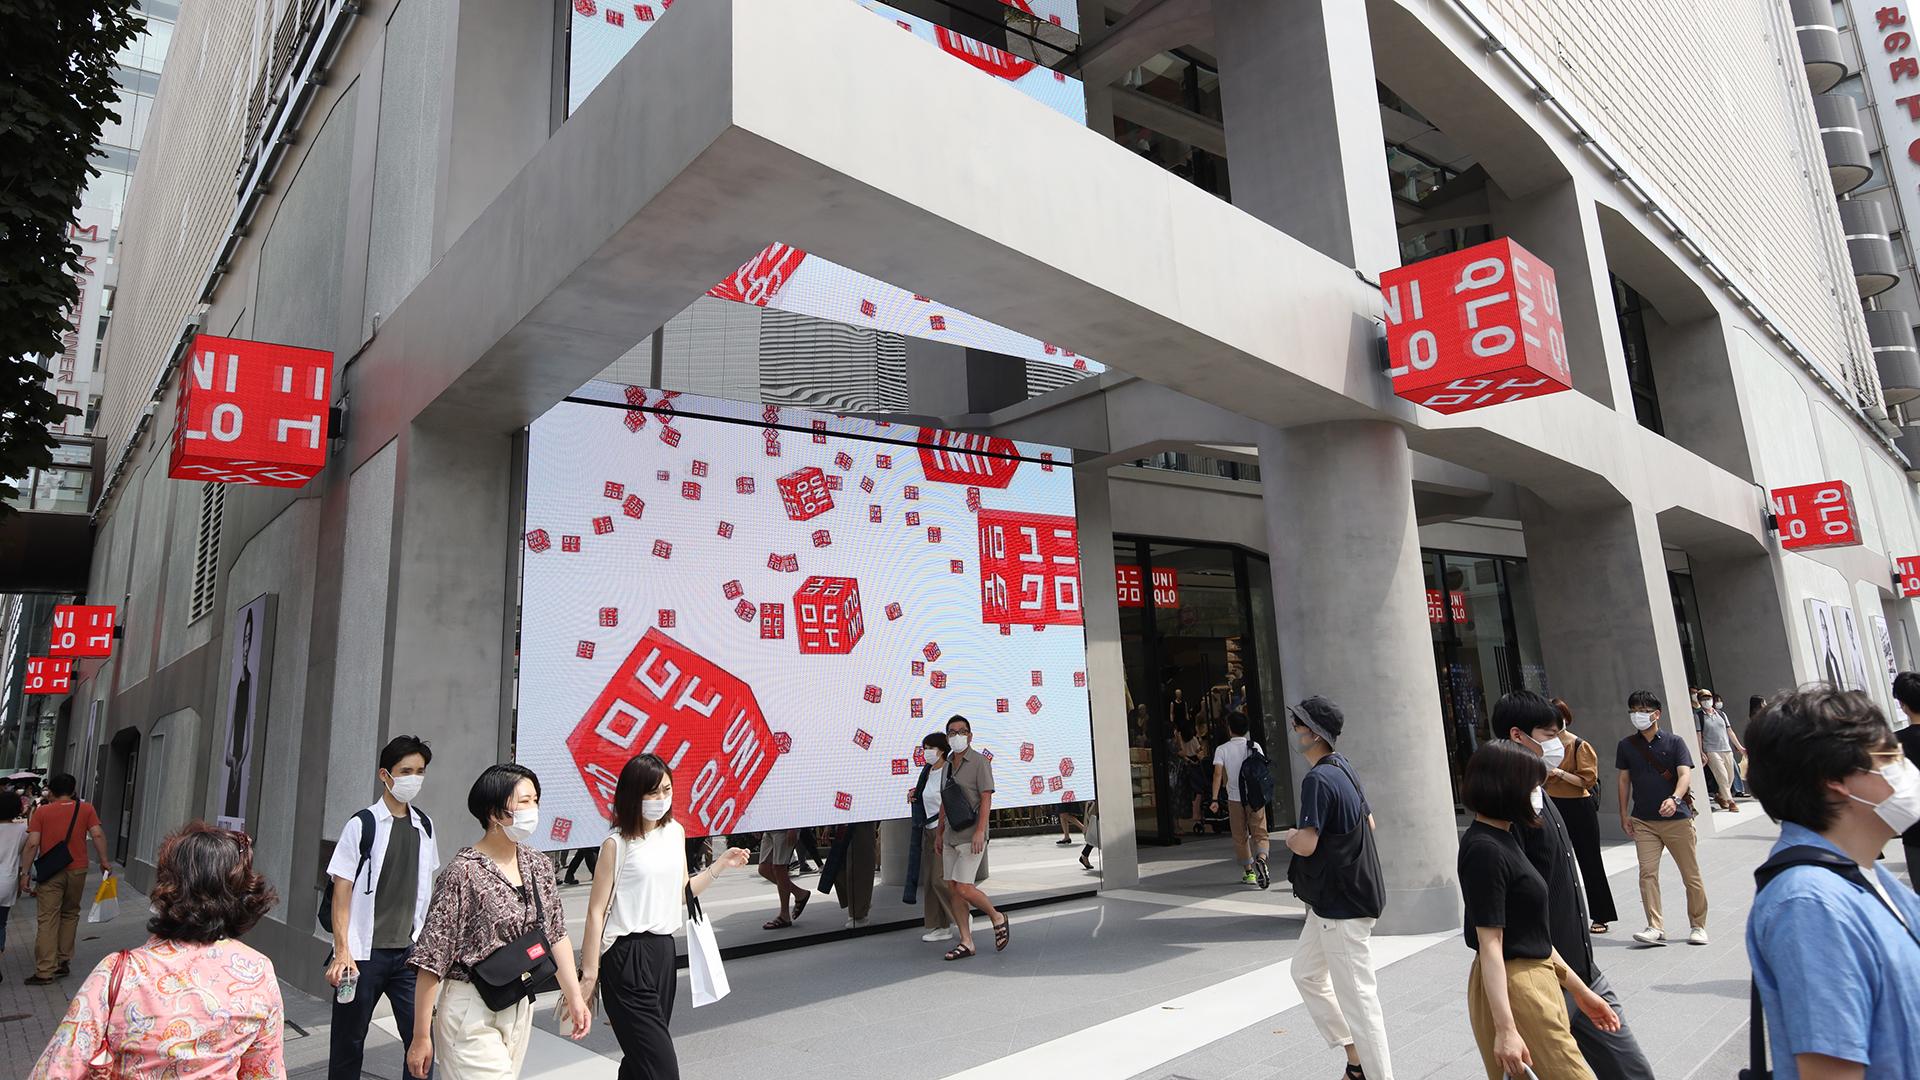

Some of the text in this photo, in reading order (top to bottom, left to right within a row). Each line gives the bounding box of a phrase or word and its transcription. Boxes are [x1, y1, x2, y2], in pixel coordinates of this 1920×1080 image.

[1875, 6, 1919, 82] 丸の内
[1455, 257, 1516, 357] QLO
[797, 481, 816, 514] QLO
[810, 475, 829, 506] UNI
[1813, 488, 1849, 536] QLO
[1019, 526, 1076, 565] ユニ
[1019, 573, 1079, 611] クロ
[1118, 570, 1139, 584] ユニ
[1118, 587, 1140, 601] クロ
[1152, 572, 1173, 587] UNI
[1153, 588, 1176, 605] QLO
[722, 709, 765, 791] UNI
[689, 759, 736, 834] QLO
